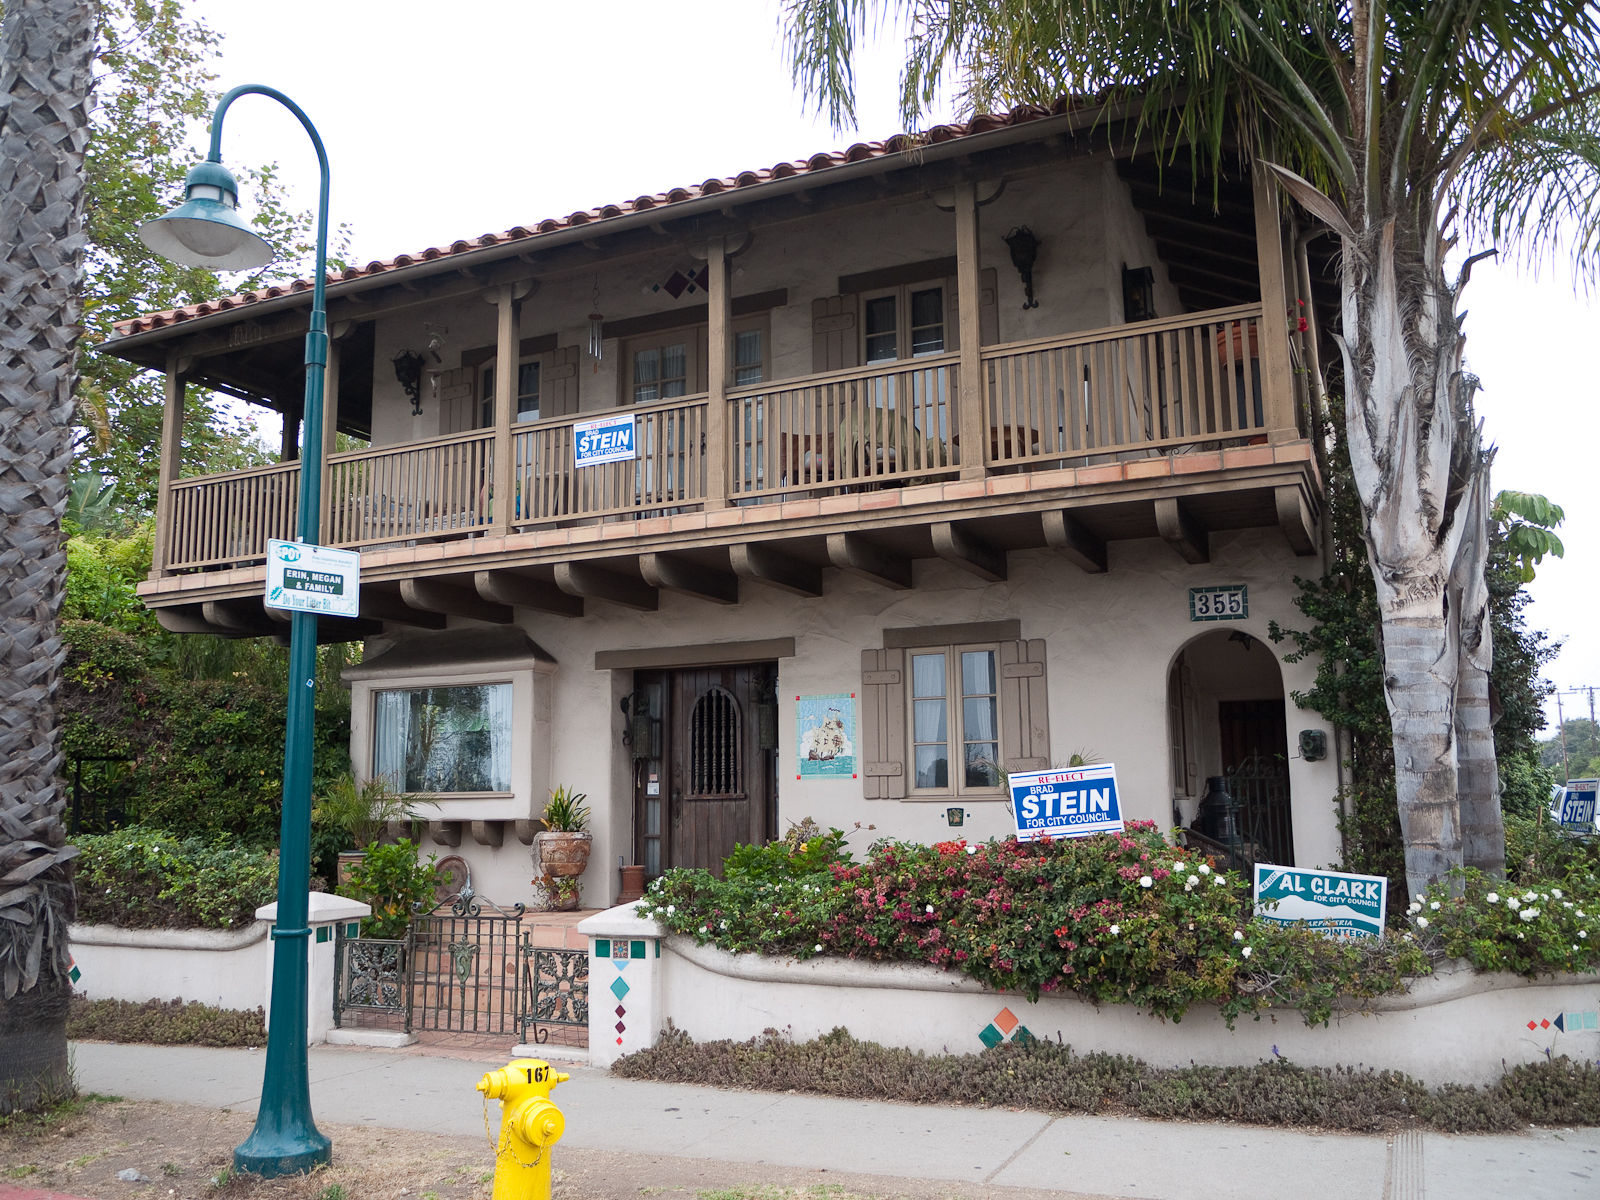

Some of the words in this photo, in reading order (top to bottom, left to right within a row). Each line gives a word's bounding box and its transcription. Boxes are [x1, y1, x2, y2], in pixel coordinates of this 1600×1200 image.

[579, 430, 630, 452] STEIN
[605, 446, 628, 454] COUNCIL
[276, 546, 300, 560] SPOT
[286, 570, 309, 581] ERIN,
[312, 574, 341, 584] MEGAN
[305, 582, 334, 593] FAMILY
[283, 594, 290, 605] Do
[292, 595, 304, 606] Your
[1198, 593, 1240, 614] 355
[1038, 772, 1084, 784] RE-ELECT
[1030, 785, 1054, 794] BRAD
[1021, 788, 1110, 819] STEIN
[1564, 800, 1594, 822] STEIN
[1026, 818, 1045, 828] FOR
[1047, 816, 1067, 826] CITY
[1069, 812, 1110, 824] COUNCIL
[1279, 874, 1306, 892] AL
[1310, 877, 1379, 900] CLARK
[1329, 896, 1346, 904] CITY
[1347, 898, 1378, 907] COUNCIL
[527, 1066, 549, 1084] 167
